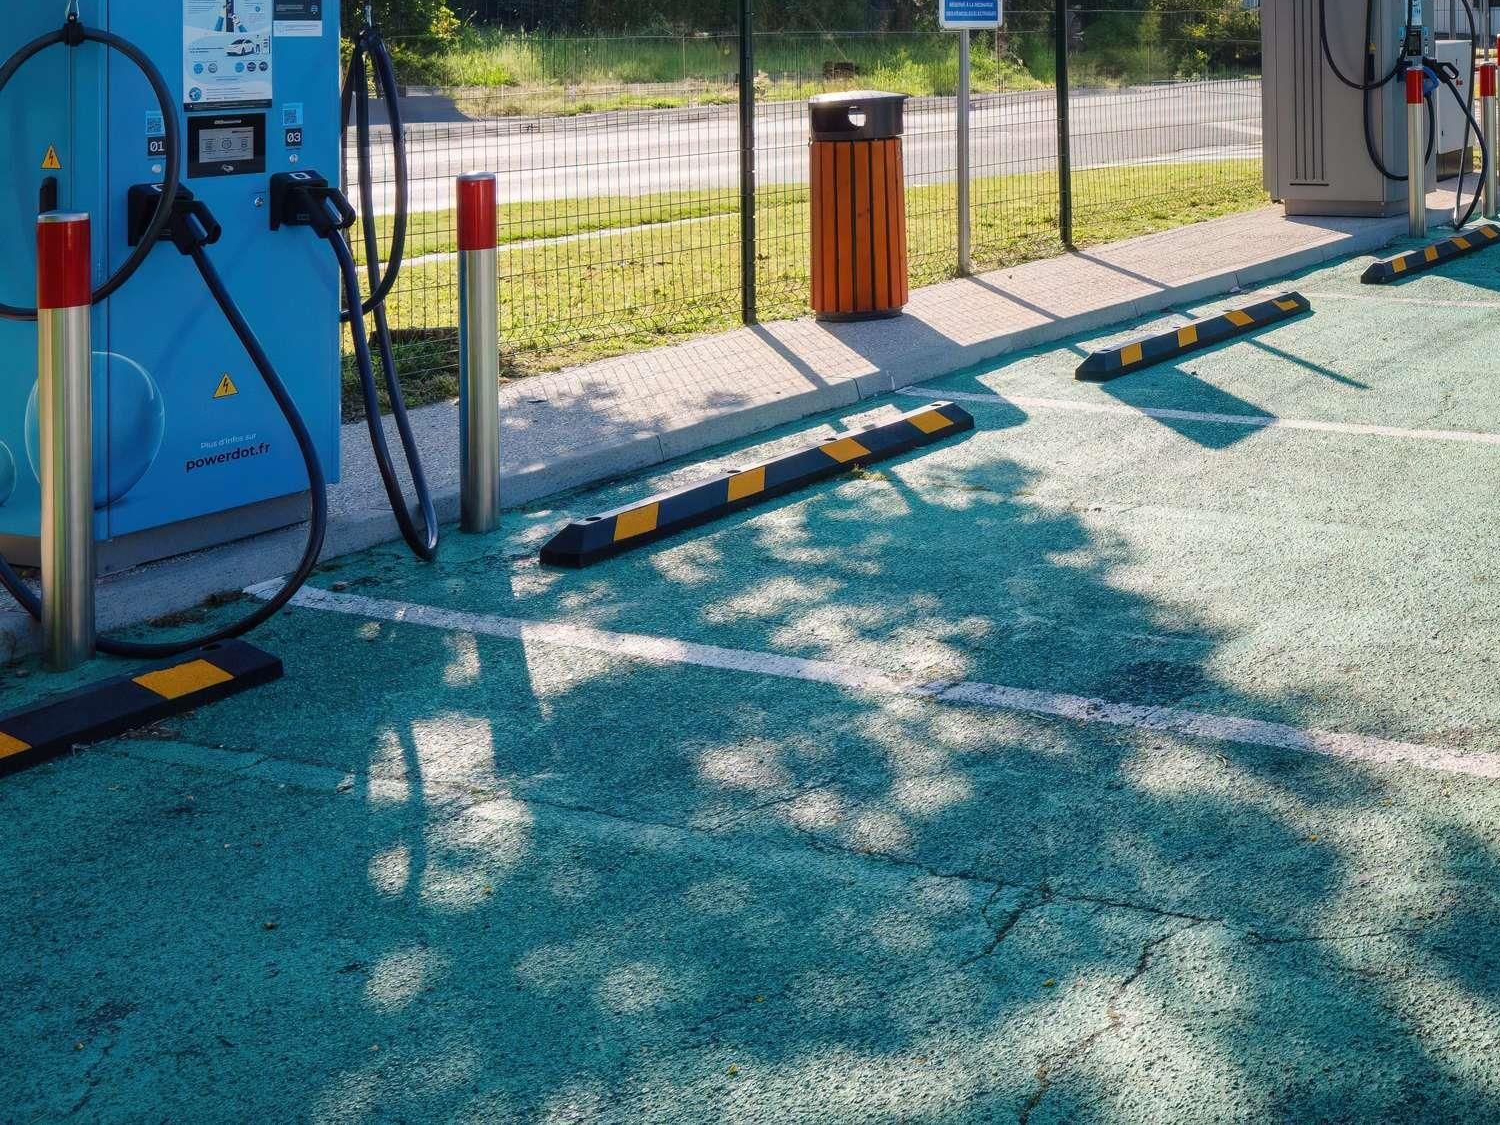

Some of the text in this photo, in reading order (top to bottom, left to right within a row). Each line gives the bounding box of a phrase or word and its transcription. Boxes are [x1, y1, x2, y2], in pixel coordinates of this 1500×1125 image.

[287, 132, 302, 143] 03
[149, 141, 165, 152] 01
[200, 441, 218, 449] Plus
[244, 433, 257, 441] sur
[186, 442, 270, 472] powerdot.fr
